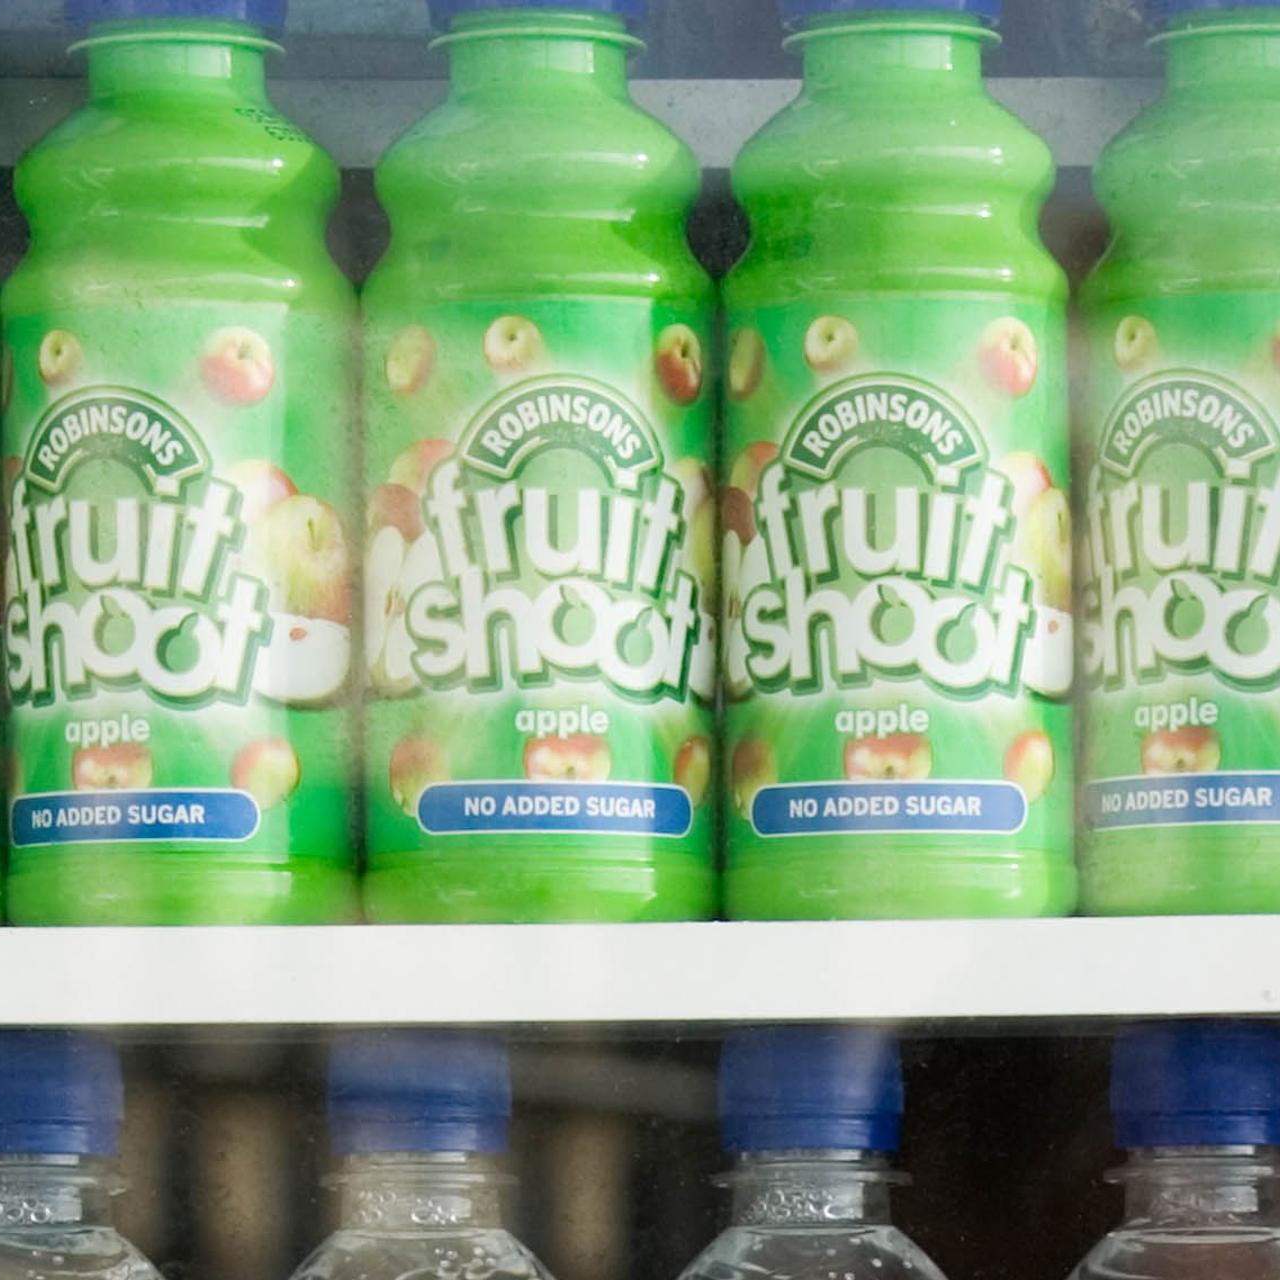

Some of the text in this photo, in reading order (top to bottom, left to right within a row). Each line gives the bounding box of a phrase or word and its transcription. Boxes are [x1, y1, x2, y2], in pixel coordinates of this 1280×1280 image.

[37, 405, 184, 469] ROBINSONS
[480, 394, 642, 460] ROBINSONS
[804, 389, 962, 456] ROBINSONS
[1114, 389, 1255, 455] ROBINSONS
[13, 472, 240, 594] fruit
[427, 460, 677, 592] fruit
[756, 464, 1011, 584] fruit
[8, 579, 268, 703] shoot
[410, 569, 697, 690] shoot
[744, 564, 1032, 686] shoot
[65, 716, 150, 746] apple
[515, 706, 609, 738] apple
[835, 704, 930, 736] apple
[1134, 699, 1218, 731] apple
[465, 796, 655, 818] NO ADDED SUGAR
